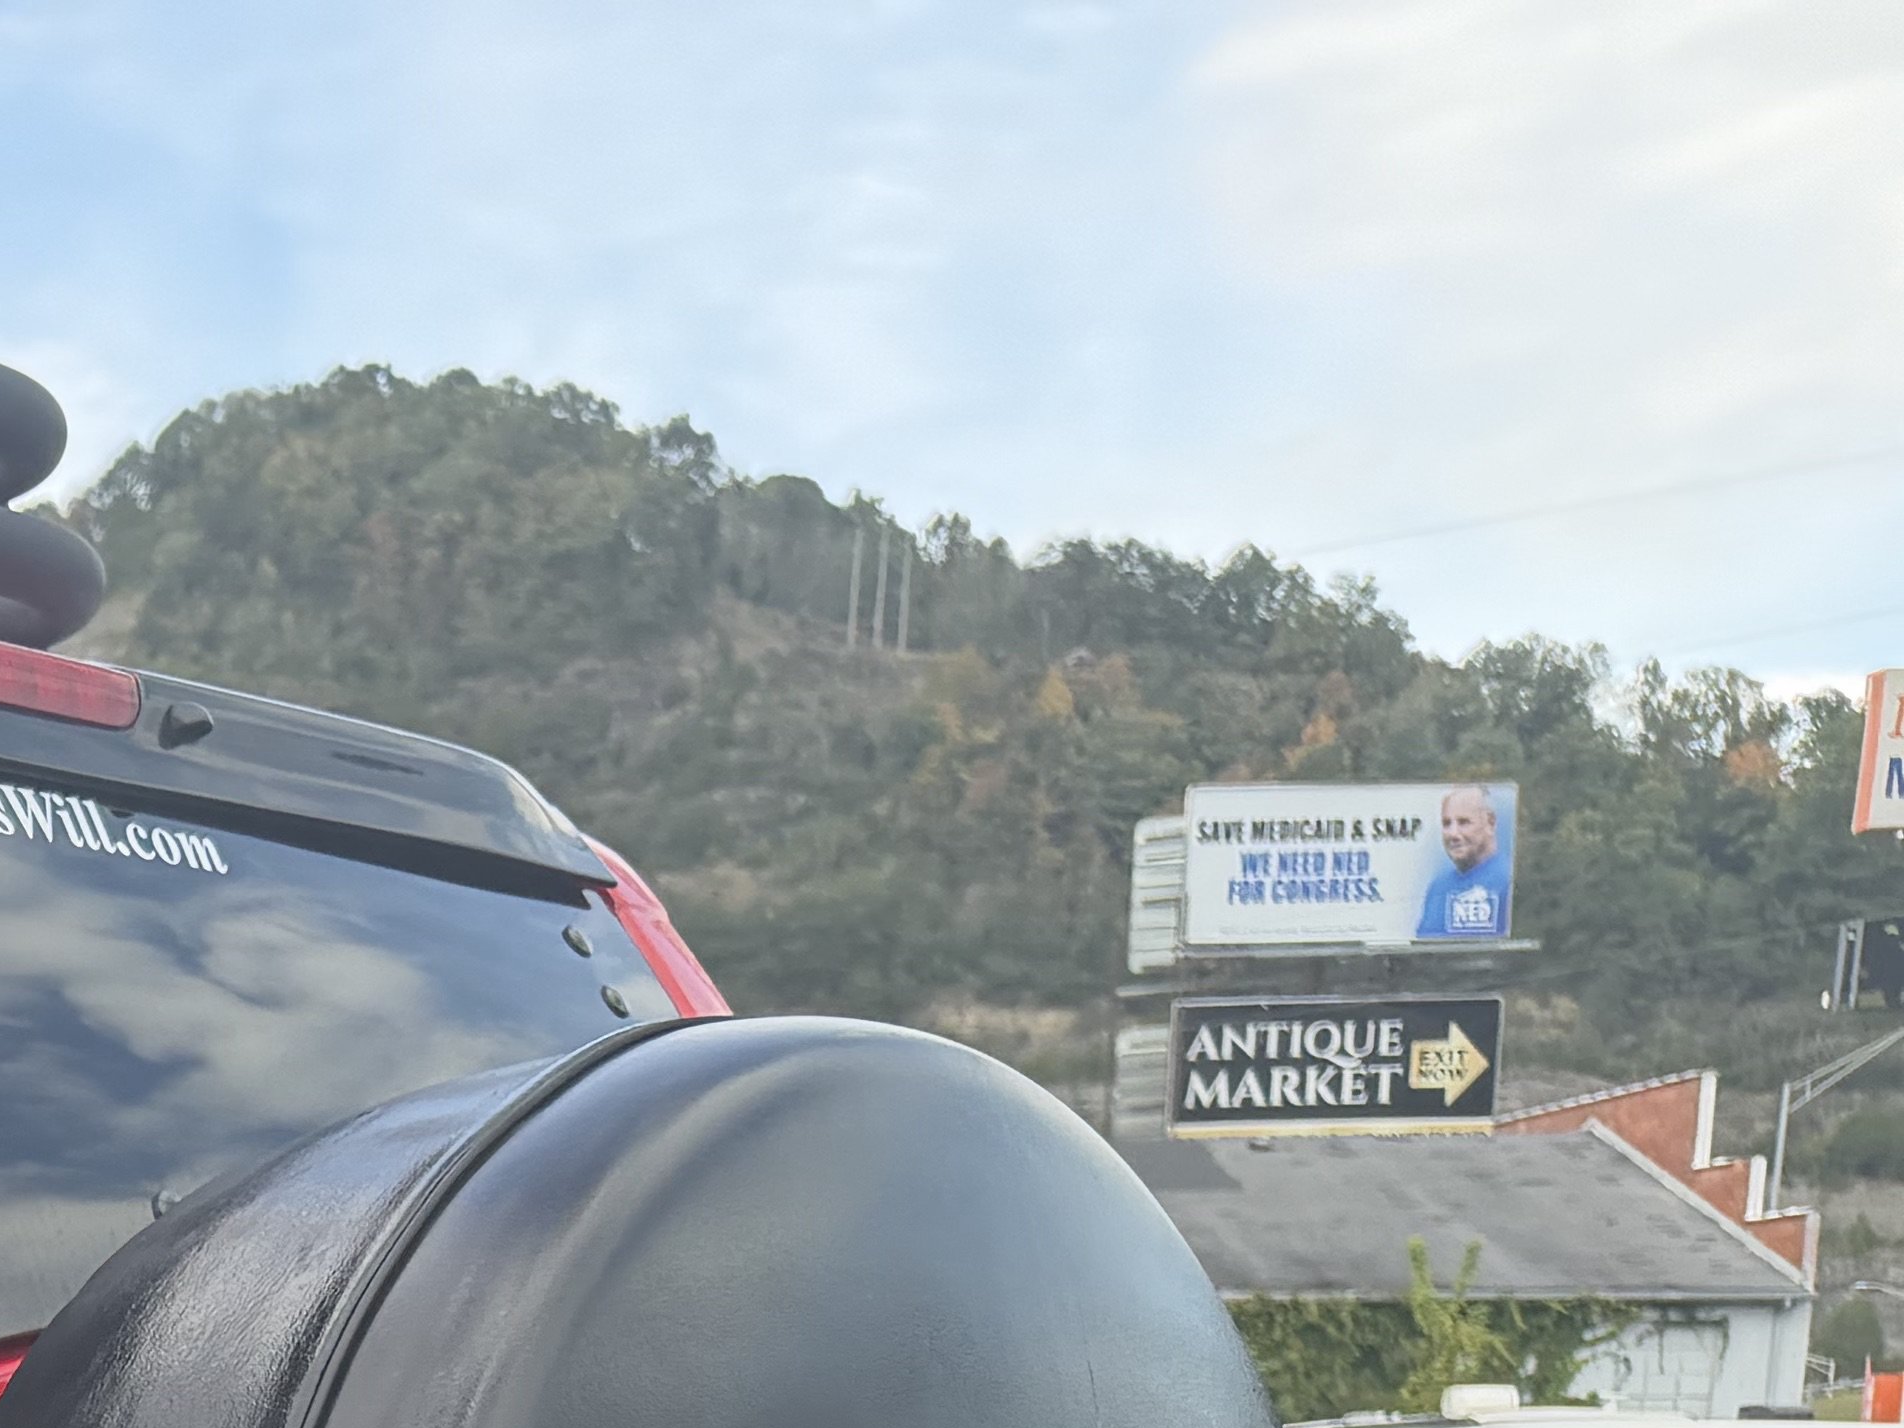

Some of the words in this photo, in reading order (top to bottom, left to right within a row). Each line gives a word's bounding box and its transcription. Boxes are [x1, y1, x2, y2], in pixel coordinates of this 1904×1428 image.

[1198, 819, 1243, 843] SAVE
[1250, 818, 1346, 842] MEDICAID
[1351, 820, 1364, 838] &
[1372, 818, 1423, 842] SNAP
[1241, 852, 1272, 877] WE
[1278, 852, 1325, 876] NEED
[1332, 851, 1370, 875] NED
[1228, 879, 1266, 904] FOR
[1186, 1018, 1404, 1068] ANTIQUE
[1419, 1050, 1469, 1066] EXIT
[1184, 1063, 1404, 1109] MARKET
[1419, 1066, 1468, 1083] NOW
